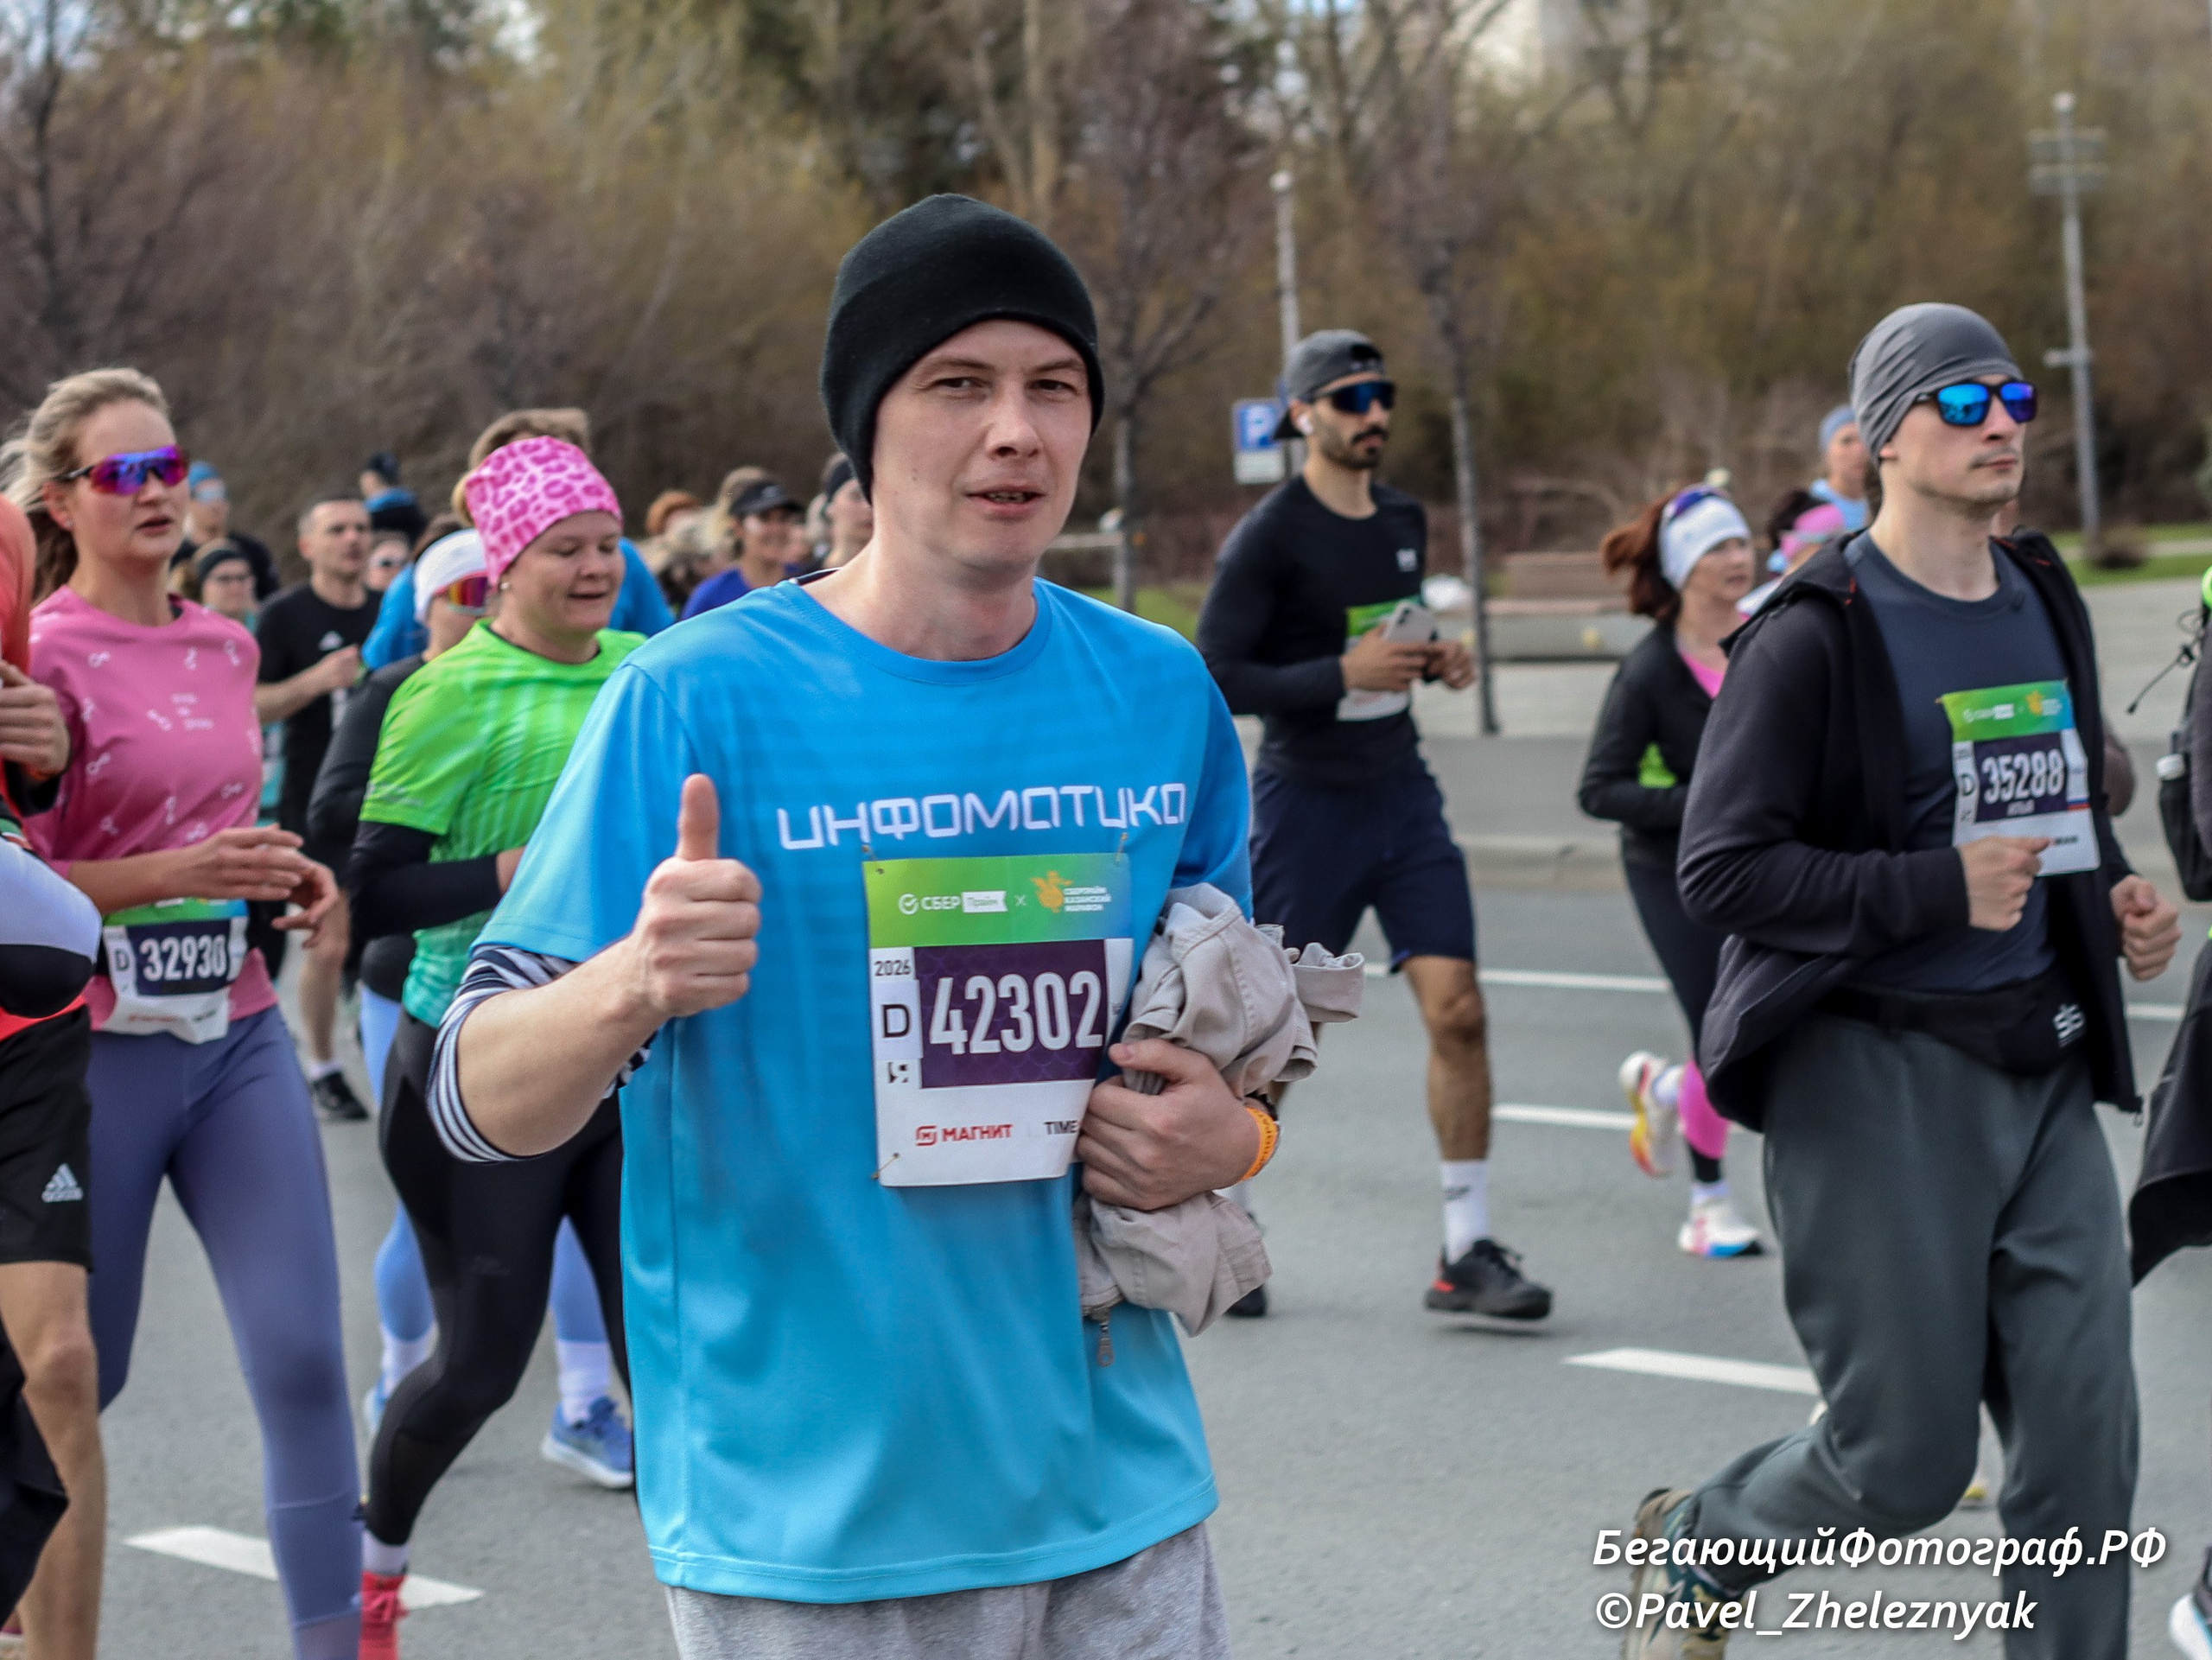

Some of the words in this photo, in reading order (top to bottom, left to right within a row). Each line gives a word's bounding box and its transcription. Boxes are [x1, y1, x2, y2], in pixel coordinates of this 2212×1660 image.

[1981, 747, 2065, 805] 35288
[874, 959, 912, 976] 2026
[881, 1003, 911, 1039] D
[929, 970, 1103, 1055] 42302
[941, 1123, 1014, 1142] МАГНИТ
